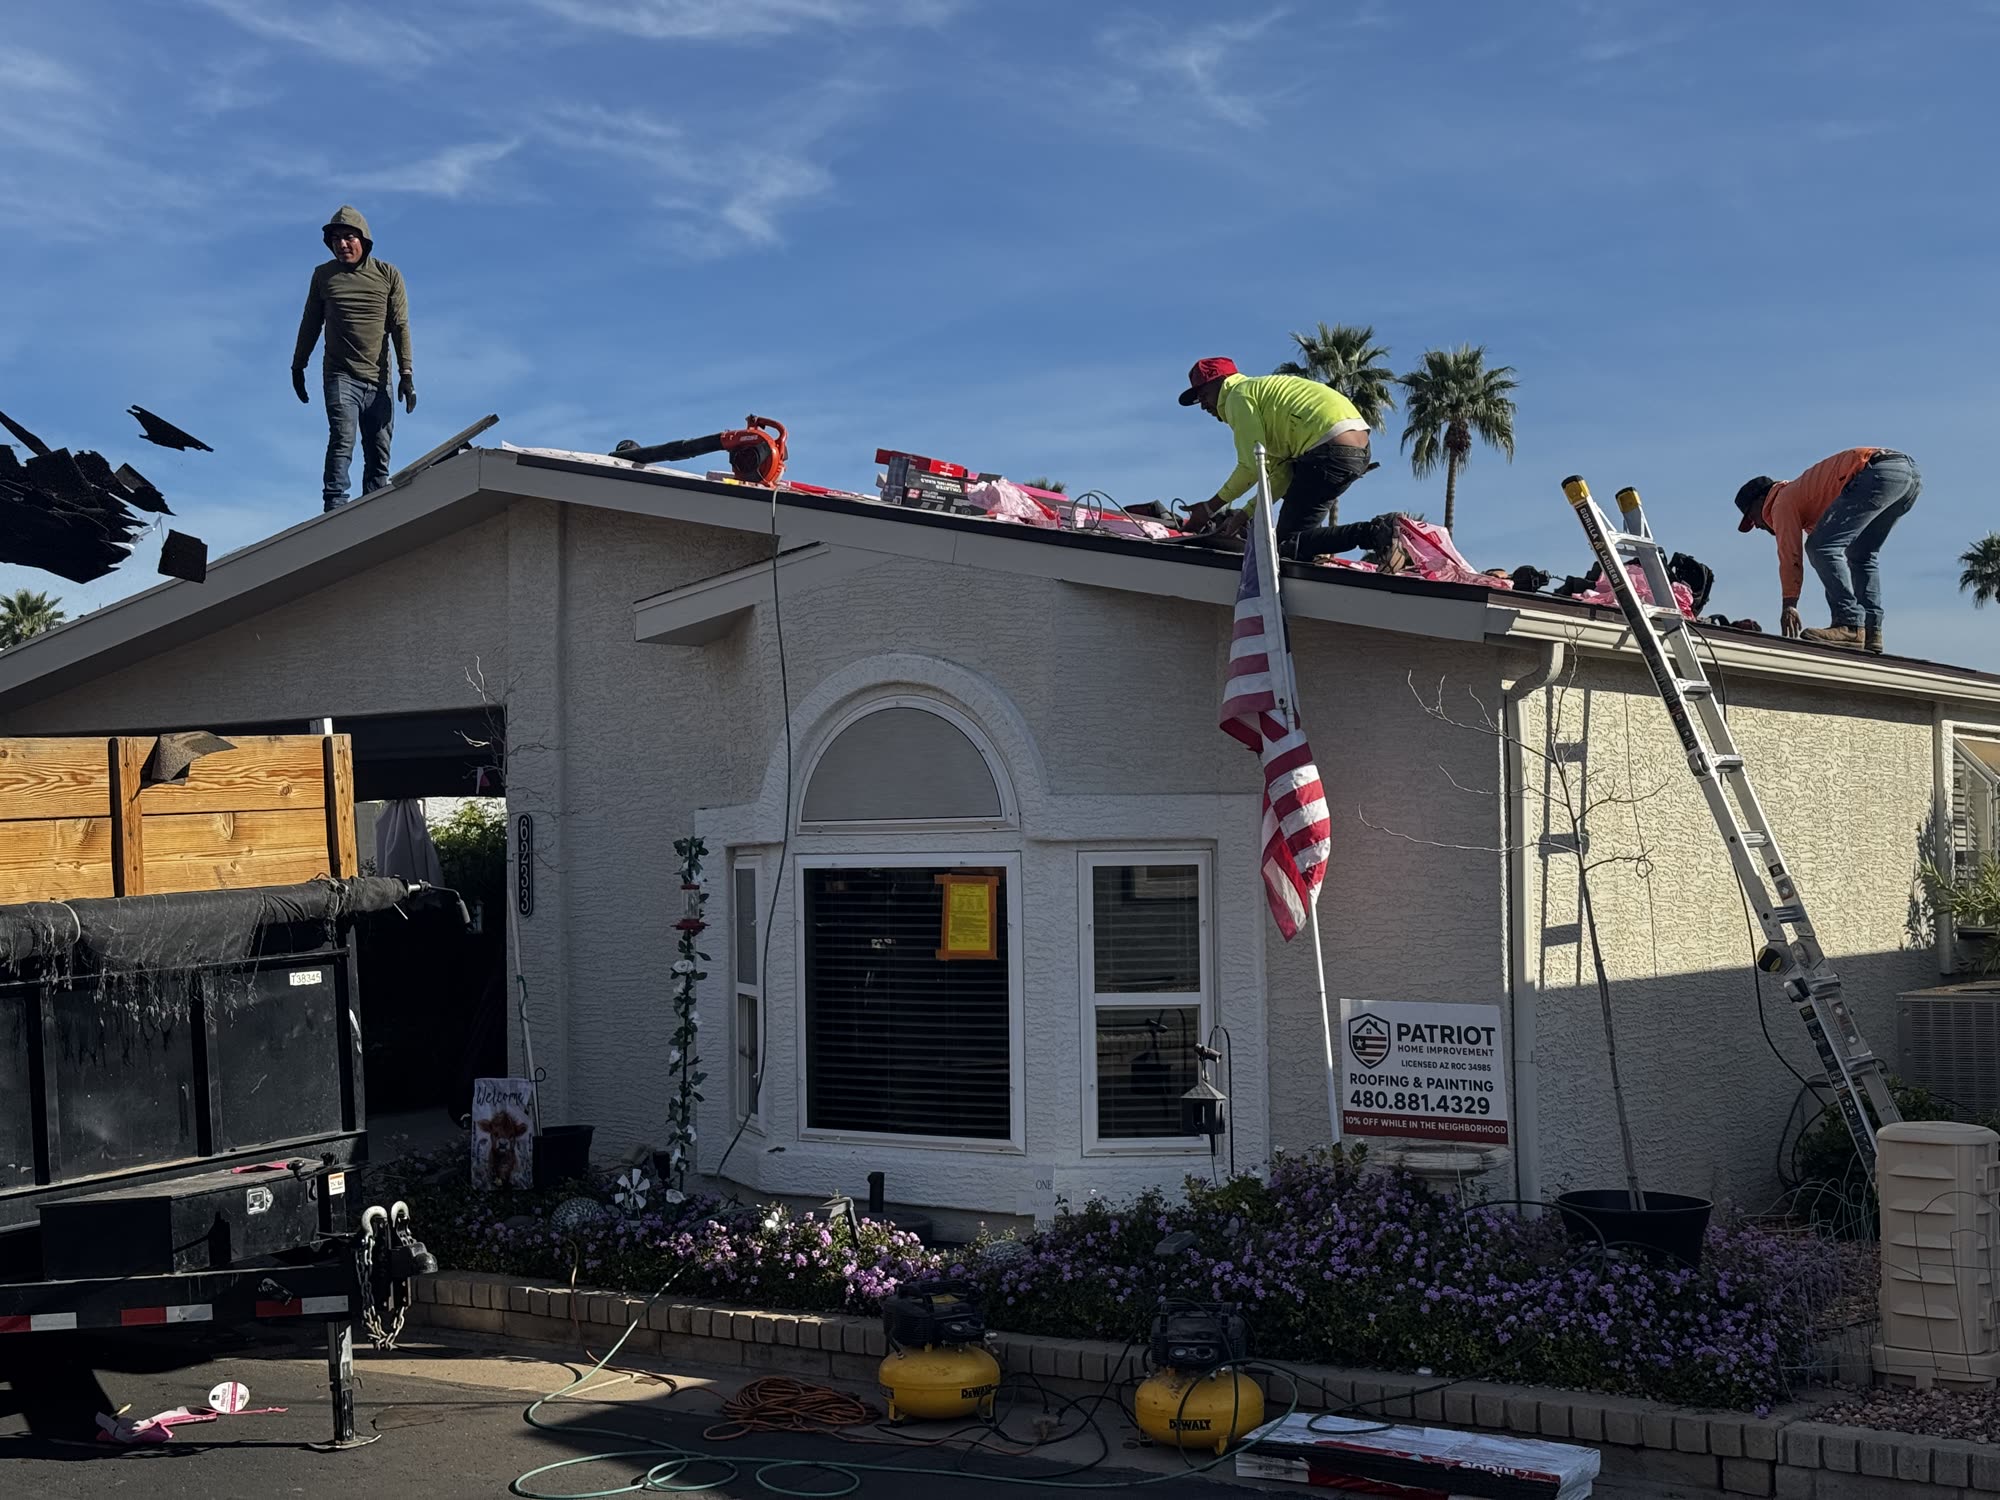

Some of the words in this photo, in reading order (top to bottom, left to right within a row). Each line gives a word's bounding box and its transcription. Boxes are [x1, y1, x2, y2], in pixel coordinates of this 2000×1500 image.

[1580, 508, 1598, 540] GORILLA
[1600, 550, 1620, 584] LADDERS
[520, 818, 529, 912] 6233
[291, 973, 320, 984] T38345
[1397, 1023, 1496, 1046] PATRIOT
[1397, 1045, 1424, 1054] HOME
[1426, 1046, 1495, 1057] IMPROVEMENT
[1401, 1060, 1438, 1069] LICENSED
[1439, 1062, 1450, 1070] AZ
[1451, 1063, 1467, 1071] ROC
[1350, 1073, 1409, 1088] ROOFING
[1413, 1077, 1423, 1089] &
[1427, 1078, 1494, 1093] PAINTING
[476, 1086, 526, 1106] Welcome
[1350, 1090, 1490, 1115] 480.881.4329
[1345, 1116, 1361, 1126] 10%
[1363, 1117, 1379, 1127] OFF
[1381, 1119, 1408, 1129] WHILE
[1409, 1120, 1418, 1129] IN
[1420, 1121, 1437, 1131] THE
[1438, 1122, 1507, 1135] NEIGHBORHOOD
